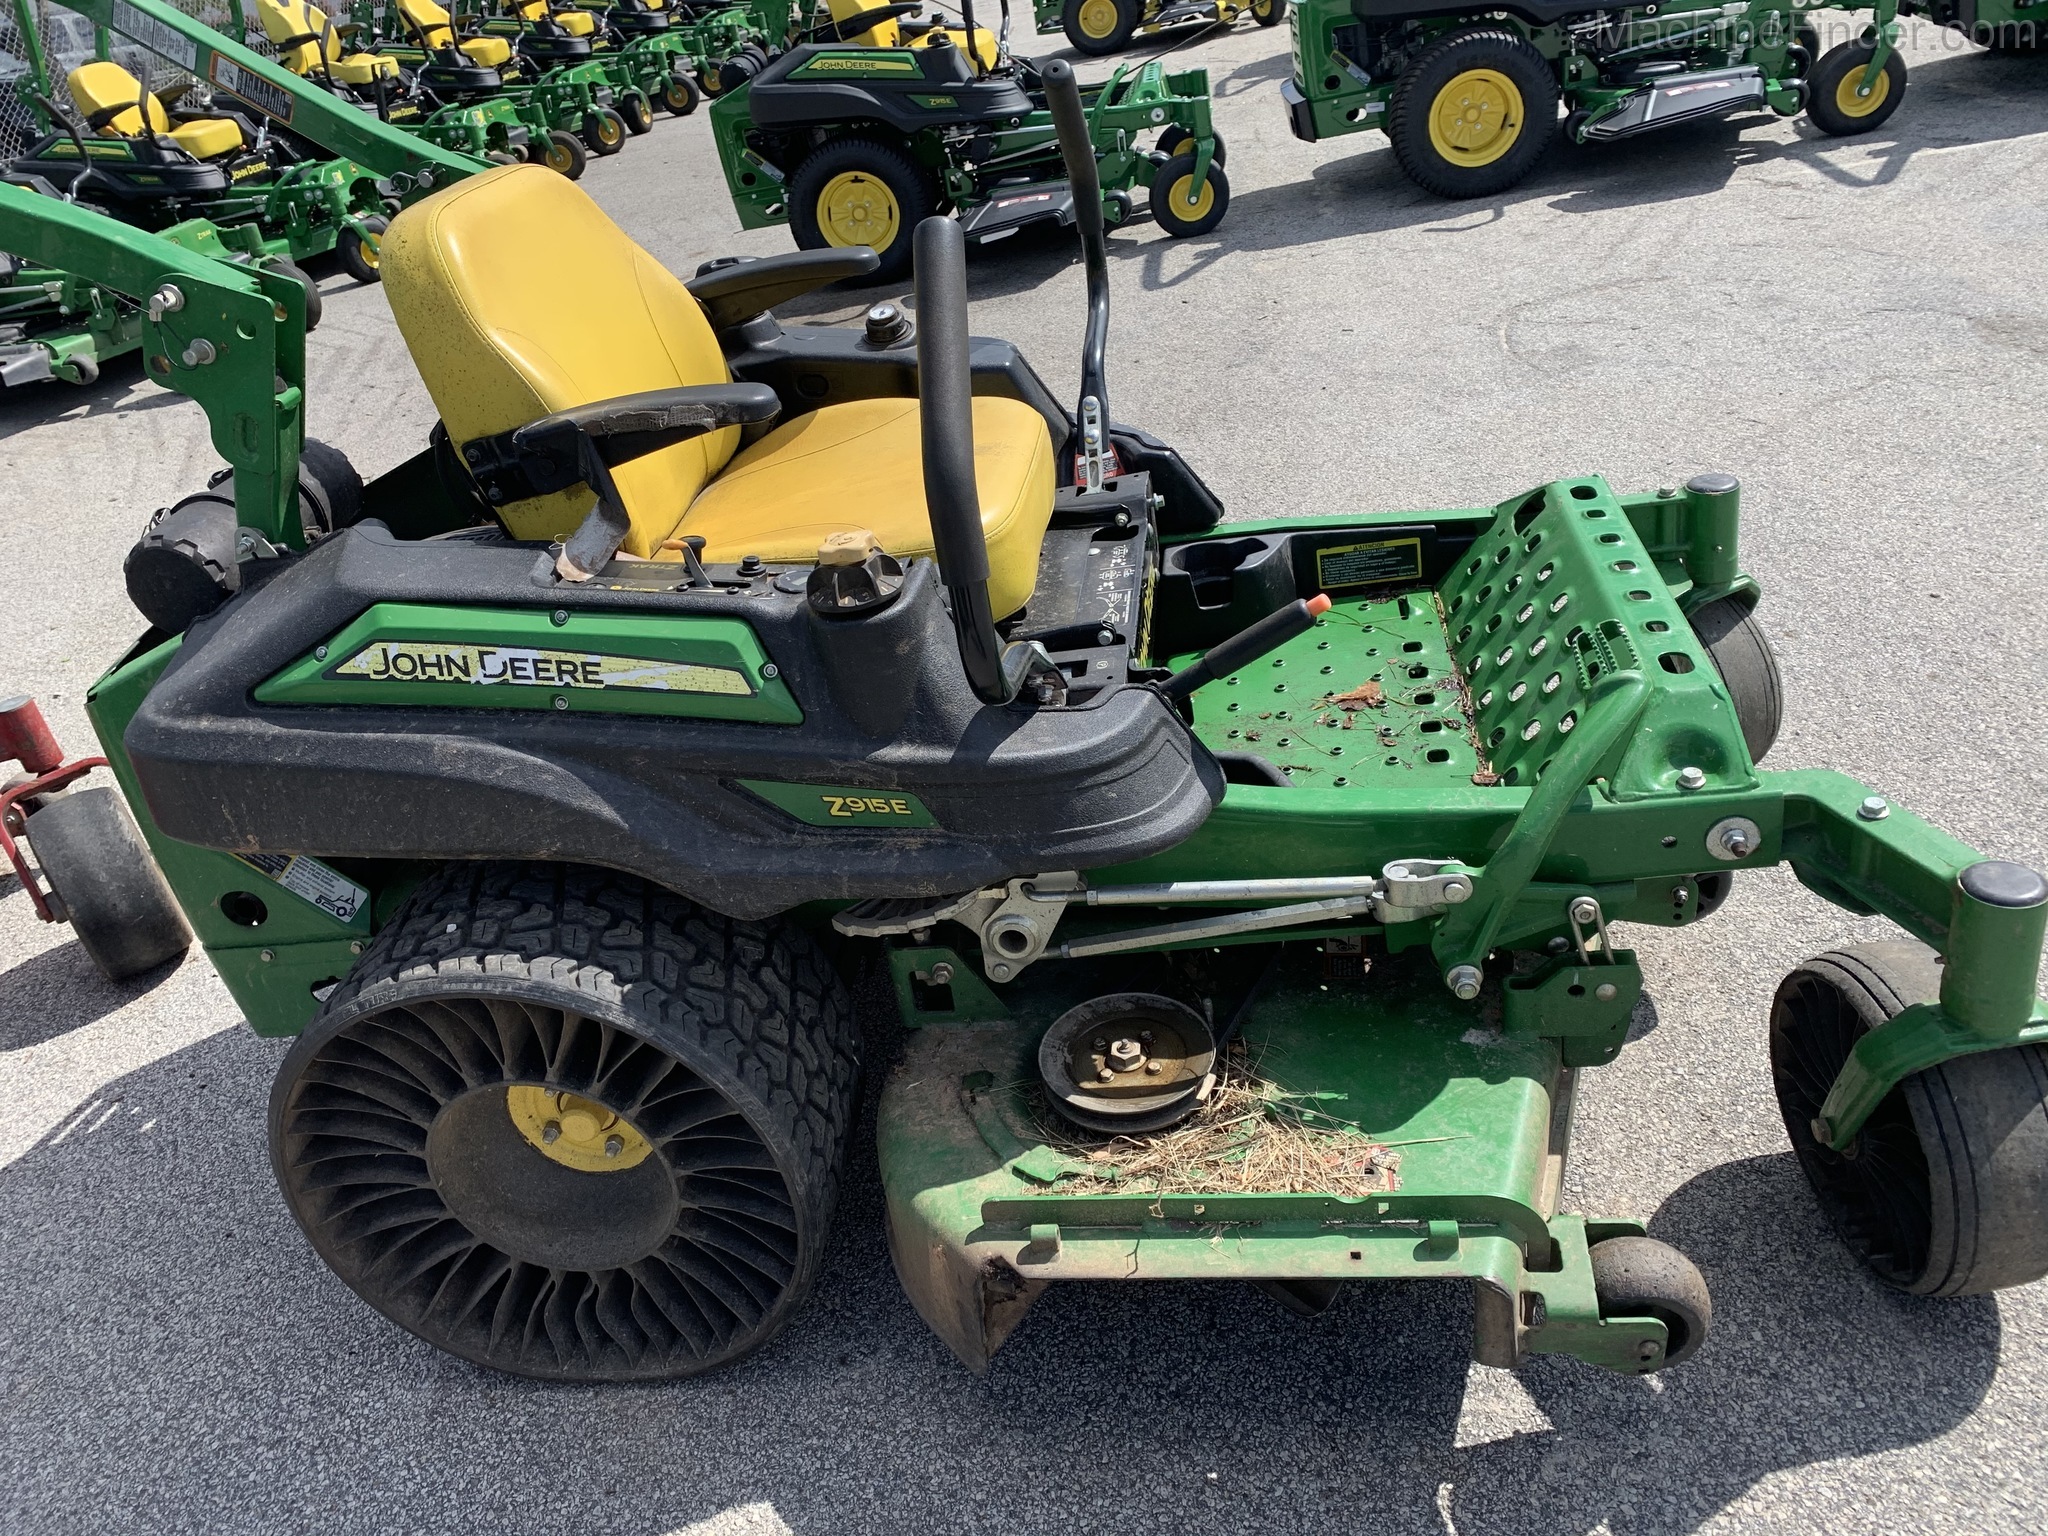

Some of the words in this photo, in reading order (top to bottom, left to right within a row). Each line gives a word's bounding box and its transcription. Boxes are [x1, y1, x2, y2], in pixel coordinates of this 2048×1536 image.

[818, 60, 844, 69] JOHN
[845, 61, 876, 69] DEERE
[372, 648, 471, 677] JOHN
[478, 650, 604, 684] DEERE
[822, 796, 912, 817] Z915E
